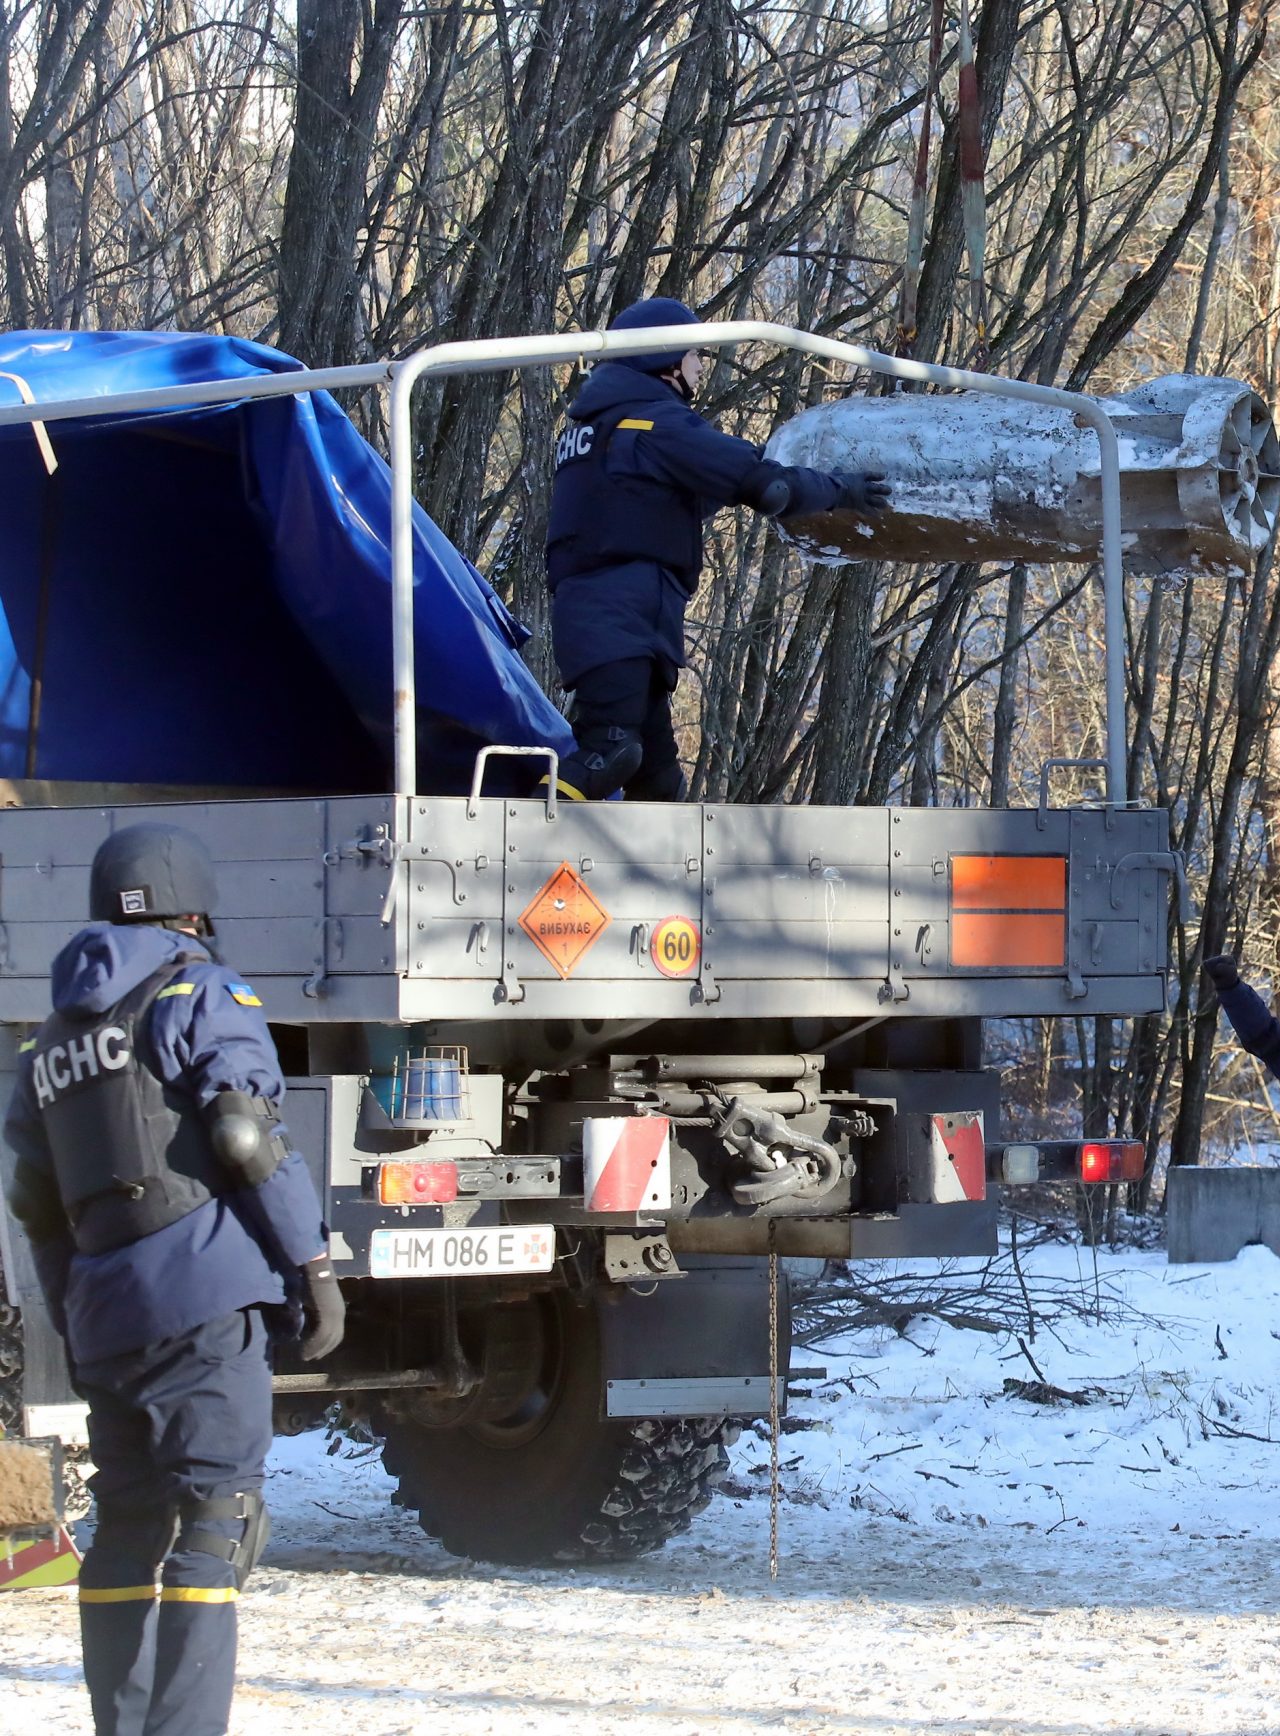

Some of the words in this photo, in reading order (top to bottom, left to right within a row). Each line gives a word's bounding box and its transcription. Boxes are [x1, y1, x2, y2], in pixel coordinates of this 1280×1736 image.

[555, 426, 594, 471] СНС
[540, 922, 591, 935] ВИБУХАЄ
[561, 942, 568, 956] 1
[663, 931, 691, 961] 60
[33, 1026, 130, 1109] ДСНС
[444, 1235, 488, 1267] 086
